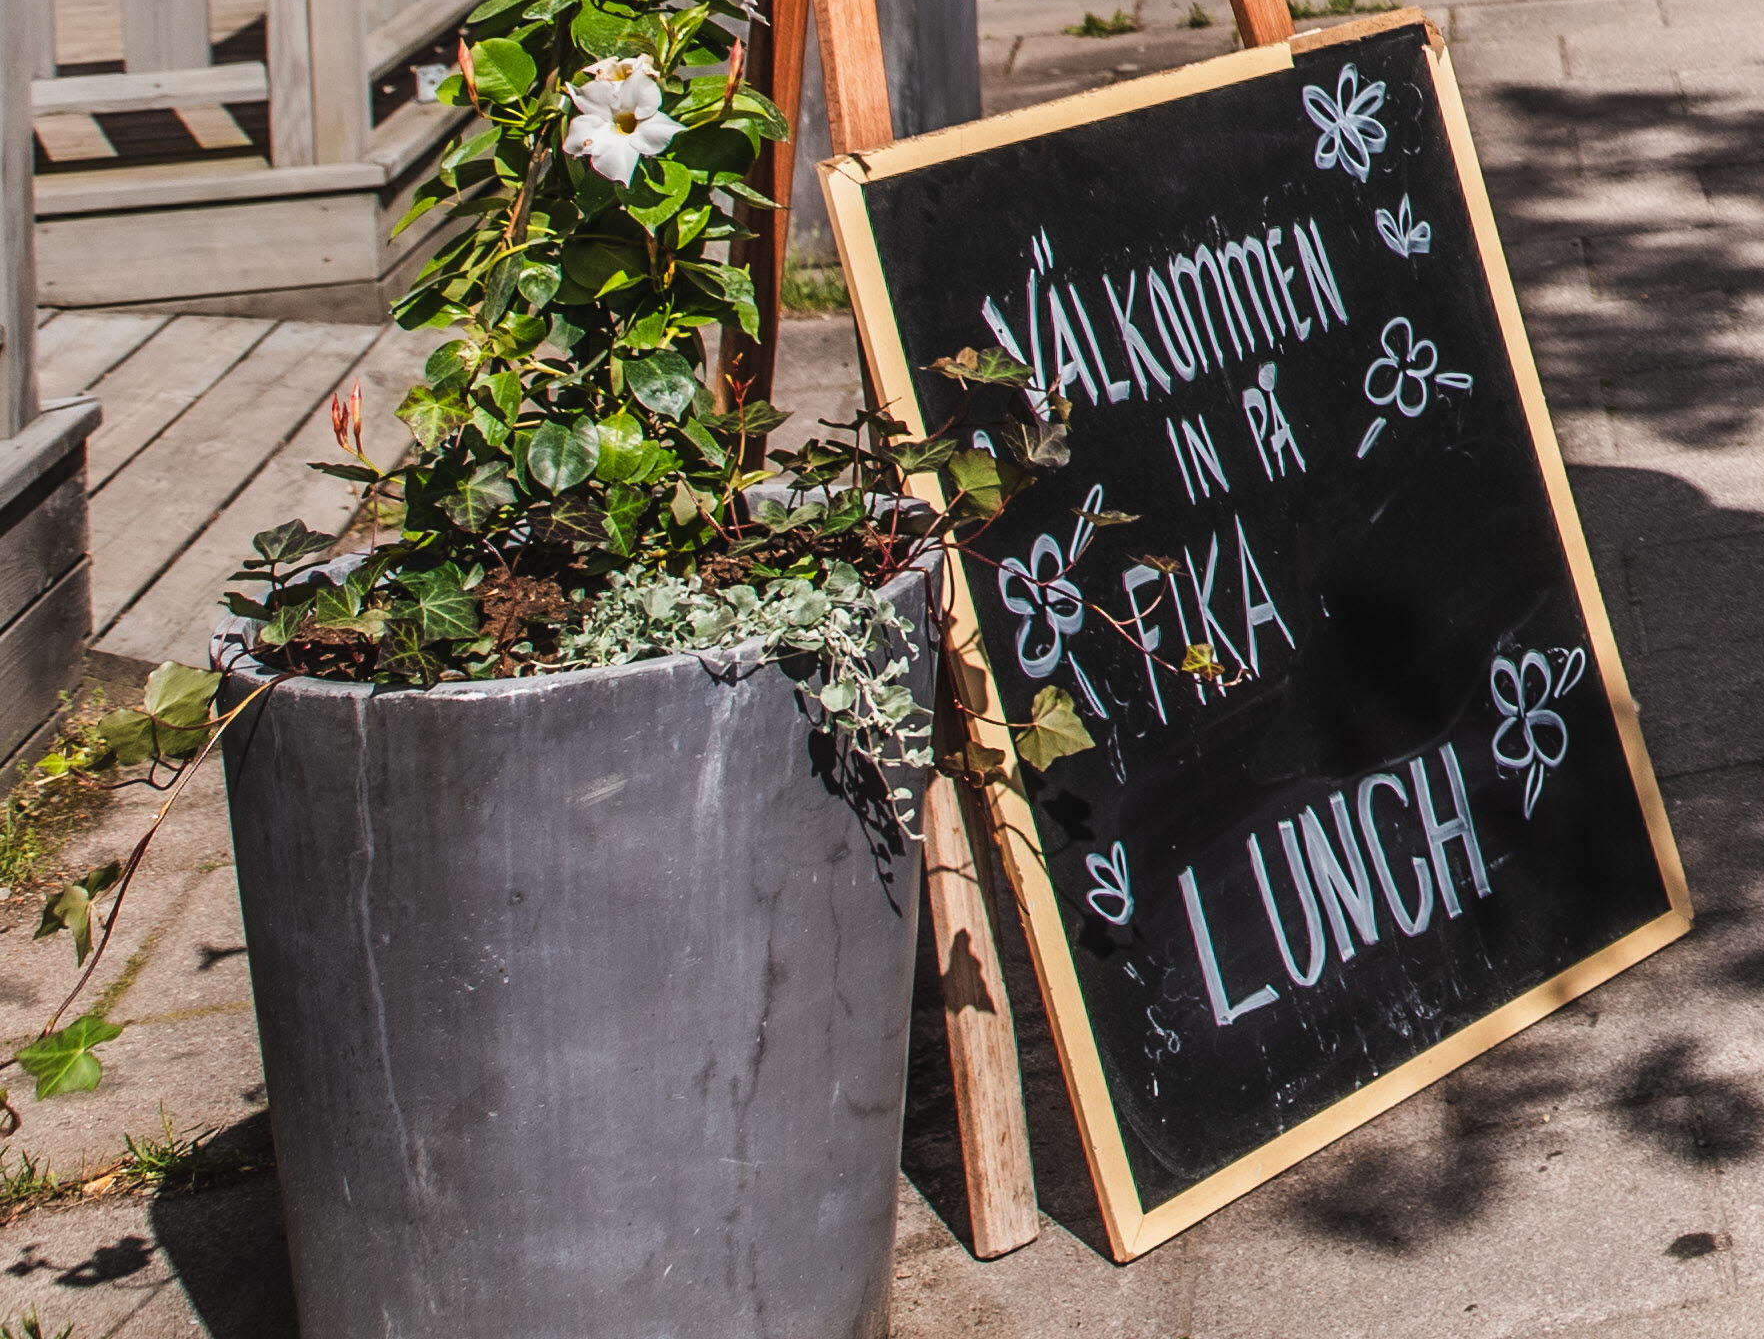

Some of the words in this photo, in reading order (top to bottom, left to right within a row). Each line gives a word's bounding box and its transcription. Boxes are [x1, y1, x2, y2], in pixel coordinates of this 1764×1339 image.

[1166, 413, 1231, 506] IN
[1242, 362, 1307, 482] PÅ
[1122, 511, 1296, 725] FIKA
[1177, 741, 1492, 1026] LUNCH
